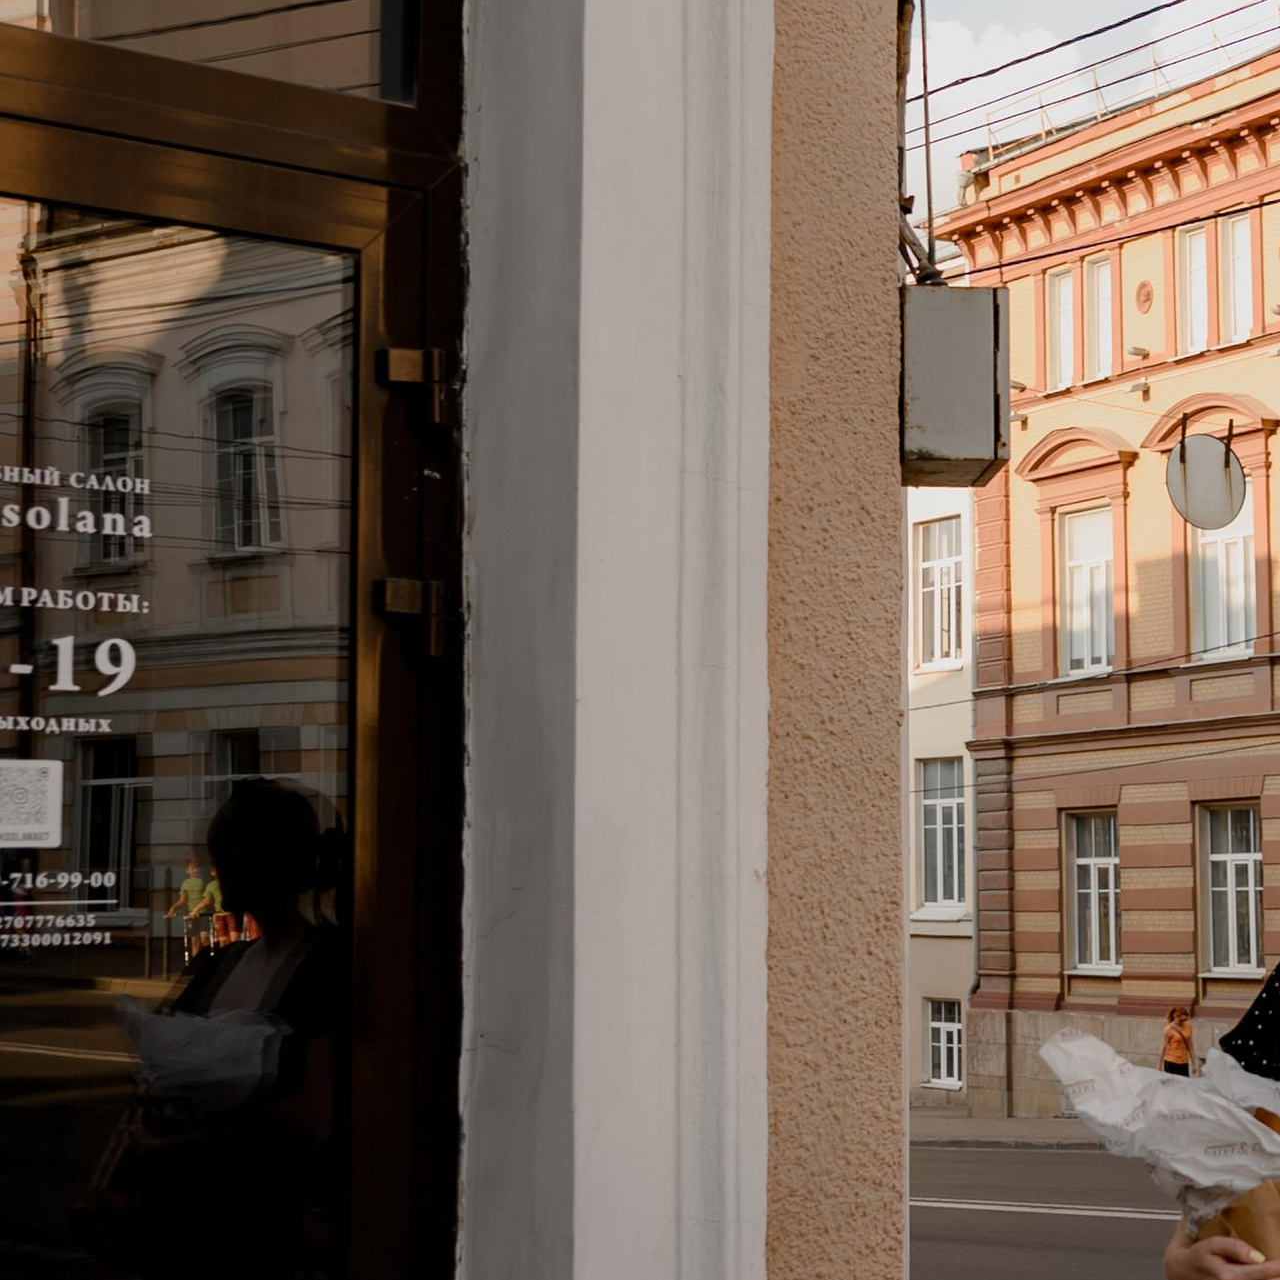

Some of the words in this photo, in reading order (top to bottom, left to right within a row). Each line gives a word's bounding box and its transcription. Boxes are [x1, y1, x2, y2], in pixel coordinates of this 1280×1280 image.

[0, 465, 61, 486] НЫЙ
[69, 471, 151, 495] САЛОН
[20, 587, 150, 614] РАБОТЫ:
[0, 871, 117, 890] -716-99-00
